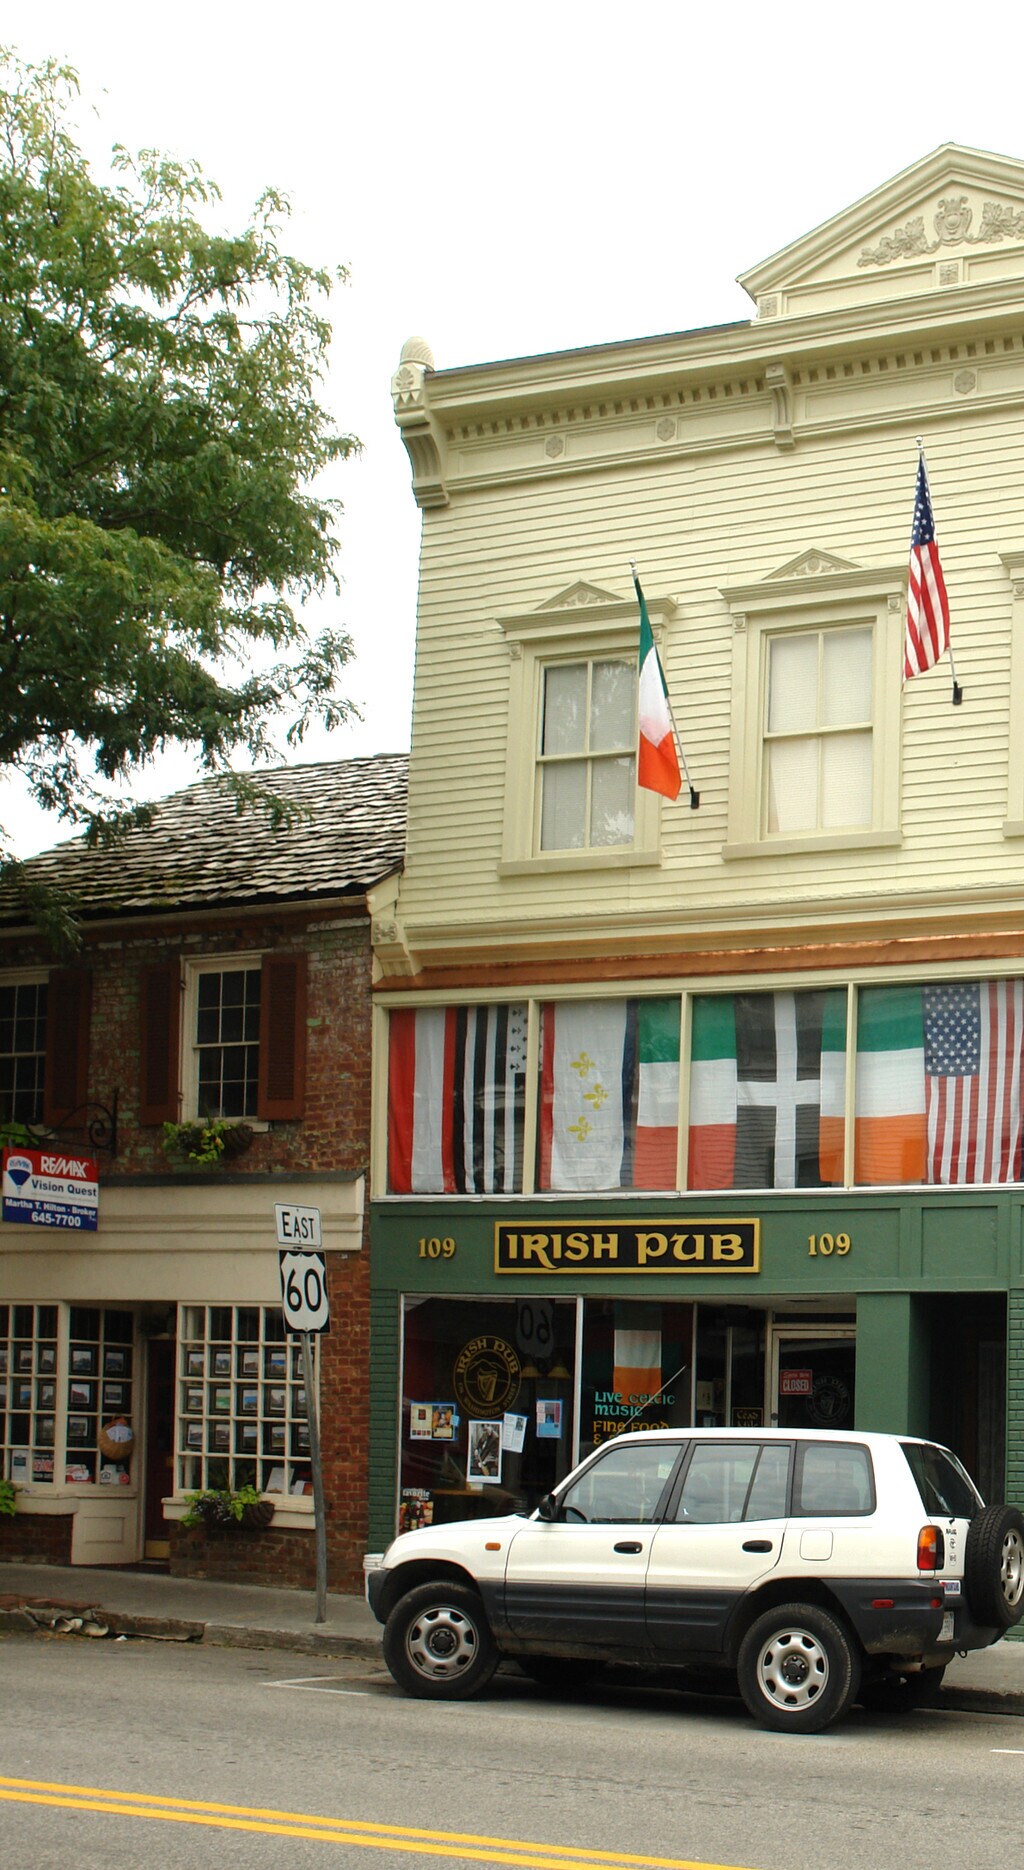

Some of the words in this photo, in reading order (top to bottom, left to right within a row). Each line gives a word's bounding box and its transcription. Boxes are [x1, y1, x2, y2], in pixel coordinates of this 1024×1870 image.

[41, 1156, 87, 1178] RE/MAX
[32, 1179, 64, 1193] Vision
[67, 1184, 97, 1197] Quest
[5, 1198, 33, 1209] Martha
[31, 1211, 81, 1227] 645-7700
[281, 1211, 314, 1239] EAST
[418, 1237, 456, 1258] 109
[506, 1232, 619, 1269] IRISH
[634, 1232, 745, 1265] PUB
[807, 1232, 851, 1256] 109
[286, 1267, 322, 1312] 60
[456, 1338, 488, 1374] IRISH
[782, 1379, 809, 1392] CLOSED
